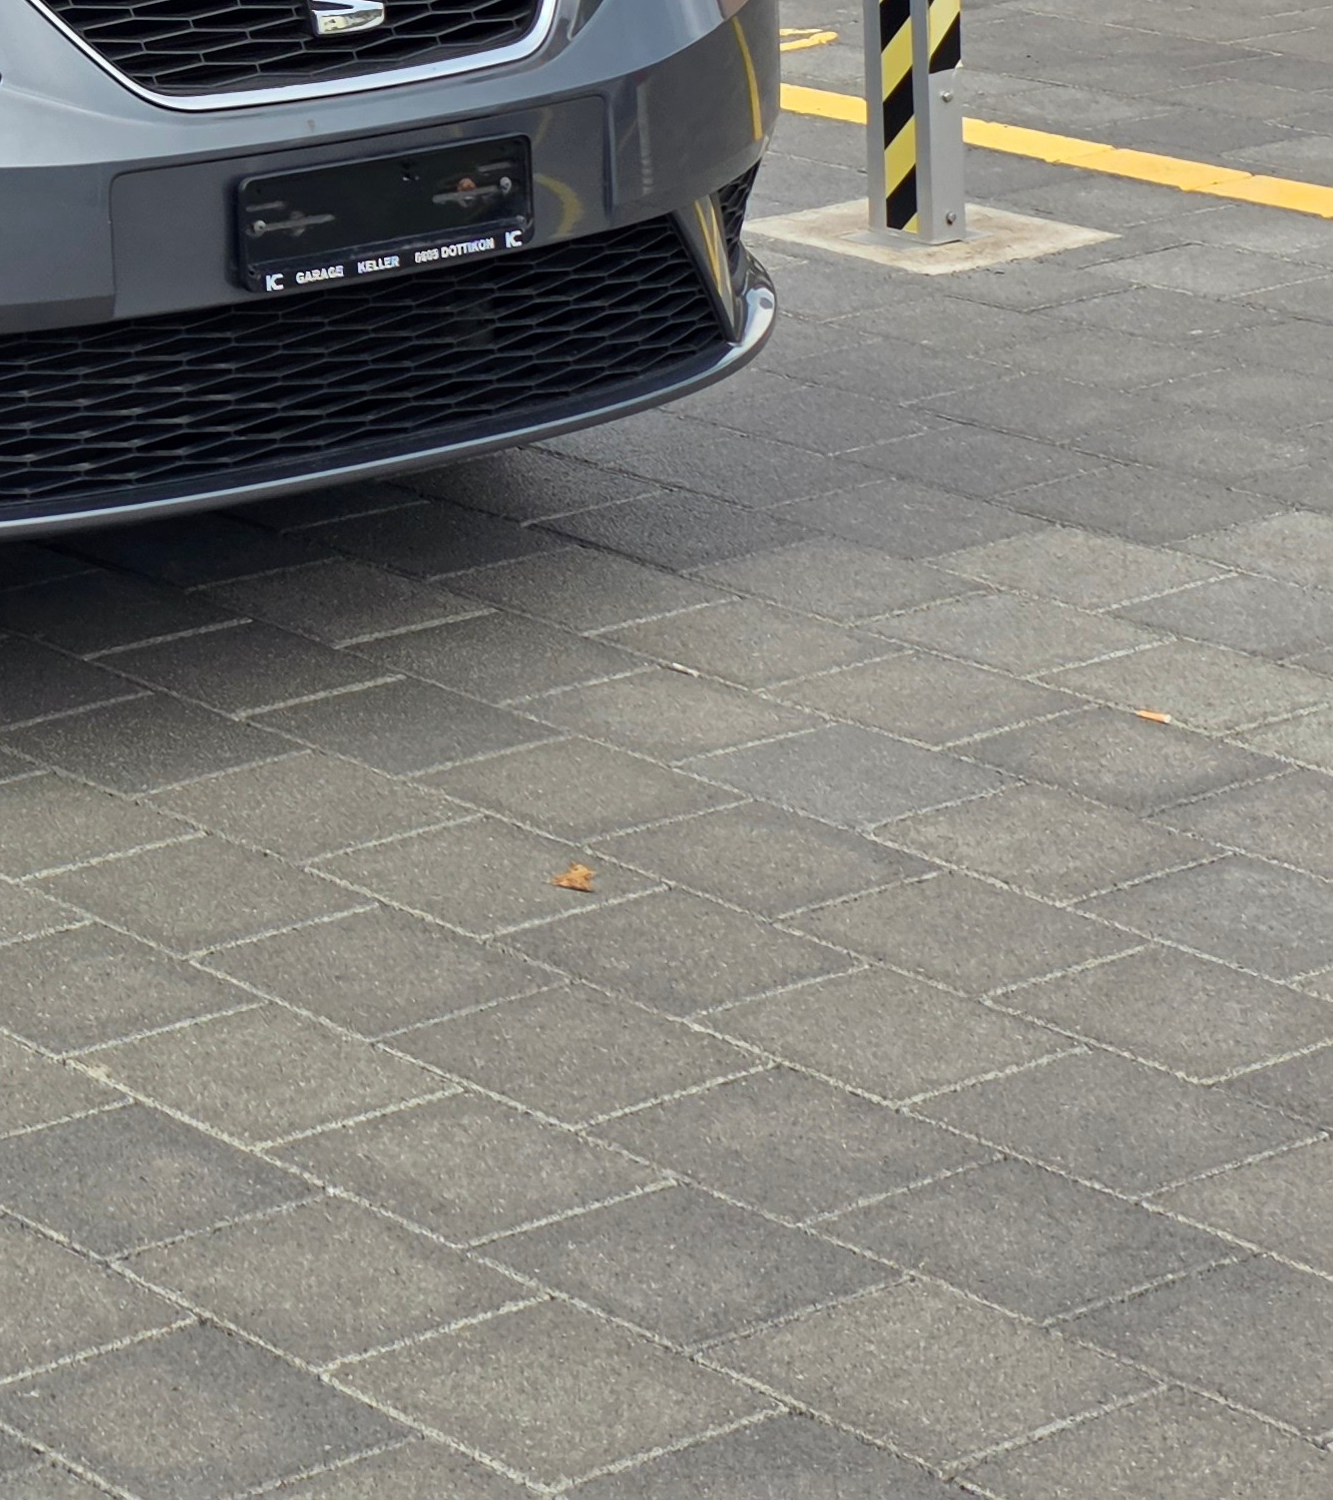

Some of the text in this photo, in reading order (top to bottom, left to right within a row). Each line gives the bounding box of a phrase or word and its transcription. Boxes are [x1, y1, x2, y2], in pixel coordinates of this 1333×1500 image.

[295, 265, 345, 284] GARAGE
[357, 255, 400, 275] KELLER
[440, 236, 495, 260] DOTTIKON
